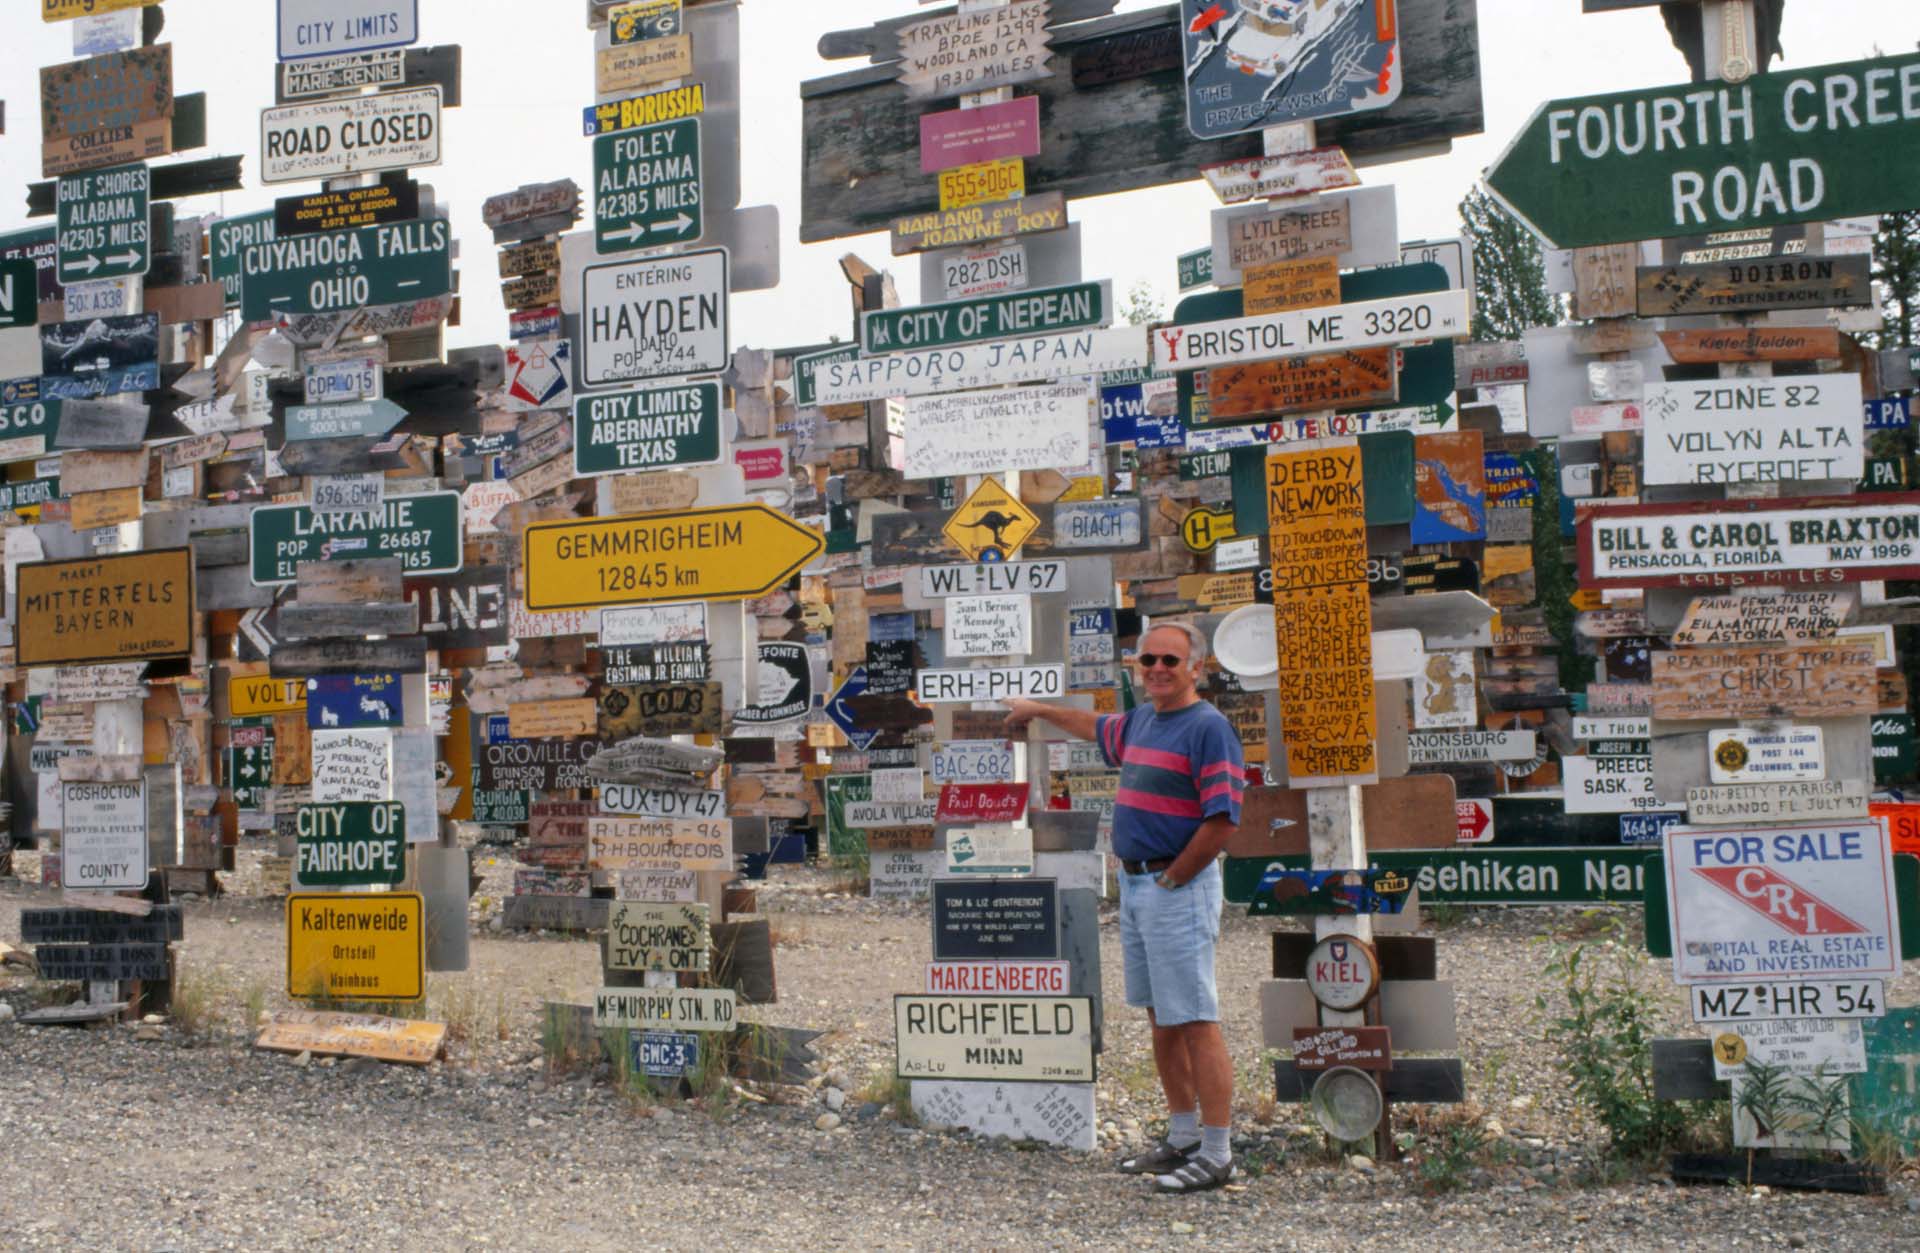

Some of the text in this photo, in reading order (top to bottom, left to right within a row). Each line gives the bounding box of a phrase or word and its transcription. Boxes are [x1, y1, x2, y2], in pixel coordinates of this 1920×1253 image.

[997, 5, 1042, 22] ELKS
[297, 12, 399, 45] CITY LIMITS
[939, 19, 1036, 52] BPOE 1299
[915, 37, 1029, 70] WOODLAND CA
[288, 62, 400, 95] MARIE RENNIE
[934, 55, 1035, 92] 1930 MILES
[1196, 84, 1233, 102] THE
[620, 84, 705, 129] BORUSSIA
[267, 112, 433, 159] ROAD CLOSED
[1548, 86, 1753, 163] FOURTH
[69, 125, 134, 151] COLLIER
[614, 129, 678, 163] FOLEY
[60, 168, 146, 202] GULF SHORES
[600, 154, 694, 192] ALABAMA
[945, 166, 1018, 200] 555 DGC
[349, 186, 390, 201] ONTARIO
[655, 181, 699, 211] MILES
[1671, 158, 1824, 225] ROAD
[70, 197, 136, 226] ALABAMA
[296, 207, 323, 220] DOUG
[349, 212, 376, 224] MILES
[898, 203, 1023, 235] HARLAND and
[111, 220, 147, 246] MILES
[920, 209, 1060, 248] JOANNE ROY
[1241, 209, 1340, 241] LYTLE REES
[246, 221, 446, 275] CUYAHOGA FALLS
[615, 264, 693, 290] ENTERING
[947, 255, 1023, 288] 282 DSH
[1729, 260, 1834, 284] DOIRON
[92, 291, 124, 311] A338
[309, 274, 370, 310] OHIO
[1833, 286, 1852, 299] FL
[591, 292, 719, 343] HAYDEN
[897, 290, 1091, 344] CITY OF NEPEAN
[633, 332, 678, 354] IDAHO
[1187, 305, 1432, 359] BRISTOL ME 3320
[614, 345, 696, 369] POP 3744
[828, 333, 1093, 387] SAPPORO JAPAN
[307, 376, 337, 395] CDP
[1694, 384, 1820, 409] ZONE 82
[590, 387, 703, 422] CITY LIMITS
[1880, 403, 1905, 423] PA
[591, 412, 703, 446] ABERNATHY
[1667, 426, 1852, 453] VOLYN ALTA
[616, 440, 677, 467] TEXAS
[1270, 456, 1356, 486] DERBY
[1697, 457, 1839, 483] RYCROFT
[1873, 461, 1895, 484] PA
[16, 480, 51, 504] HEIGHTS
[315, 482, 379, 504] 696 GMH
[1270, 479, 1362, 515] NEW YORK
[294, 500, 414, 535] LARAMIE
[1072, 513, 1122, 538] BIACH
[1336, 506, 1363, 520] 1996
[276, 529, 432, 557] POP 26687
[556, 520, 743, 560] GEMMRIGHEIM
[1190, 517, 1211, 545] H
[1598, 515, 1920, 551] BILL & CAROL BRAXTON
[1608, 543, 1912, 569] PENSACOLA, FLORIDA MAY 1996
[59, 564, 103, 582] MARKT
[598, 562, 699, 593] 12845 km
[1028, 563, 1058, 588] 67
[1275, 558, 1367, 588] SPONSERS
[25, 580, 174, 614] MITTERFELS
[55, 609, 135, 634] BAYERN
[1074, 613, 1102, 630] 2174
[1708, 632, 1785, 643] ASTORIA
[607, 645, 702, 666] THE WILLIAM
[1757, 653, 1785, 668] THE
[605, 661, 706, 684] EASTMAN FAMILY
[1029, 669, 1059, 695] 20
[1720, 667, 1813, 690] CHRIST
[246, 681, 307, 705] VOLTZ
[1789, 733, 1816, 743] LEGION
[487, 742, 578, 765] OROVILLE,
[933, 753, 1011, 777] BAC-682
[1411, 746, 1489, 764] PENNSYLVANIA
[1595, 758, 1654, 774] PREECE
[1798, 761, 1818, 771] OHIO
[1305, 760, 1361, 774] GIRLS
[67, 784, 141, 802] COSHOCTON
[472, 788, 522, 805] GEORGIA
[1583, 778, 1632, 795] SASK.
[1778, 782, 1843, 796] PARRISH
[694, 794, 721, 817] 47
[852, 803, 936, 822] AVOLA VILLAGE
[1695, 796, 1842, 816] ORLANDO JULY
[297, 804, 402, 838] CITY OF
[697, 823, 721, 838] 96
[297, 840, 398, 873] FAIRHOPE
[891, 854, 915, 864] CIVIL
[1694, 832, 1863, 867] FOR SALE
[79, 863, 129, 880] COUNTY
[884, 862, 924, 874] DEFENSE
[301, 907, 408, 931] Kaltenweide
[643, 911, 665, 921] THE
[333, 944, 376, 961] Ortsteil
[1685, 935, 1885, 957] CAPITAL REAL ESTATE
[615, 949, 703, 969] IVY ONT
[1705, 953, 1871, 973] AND INVESTMENT
[930, 966, 1063, 992] MARIENBERG
[1315, 961, 1365, 983] KIEL
[679, 996, 709, 1022] STN.
[714, 996, 734, 1022] RD
[1836, 984, 1876, 1015] 54
[906, 1002, 1075, 1036] RICHFIELD
[964, 1047, 1024, 1066] MINN
